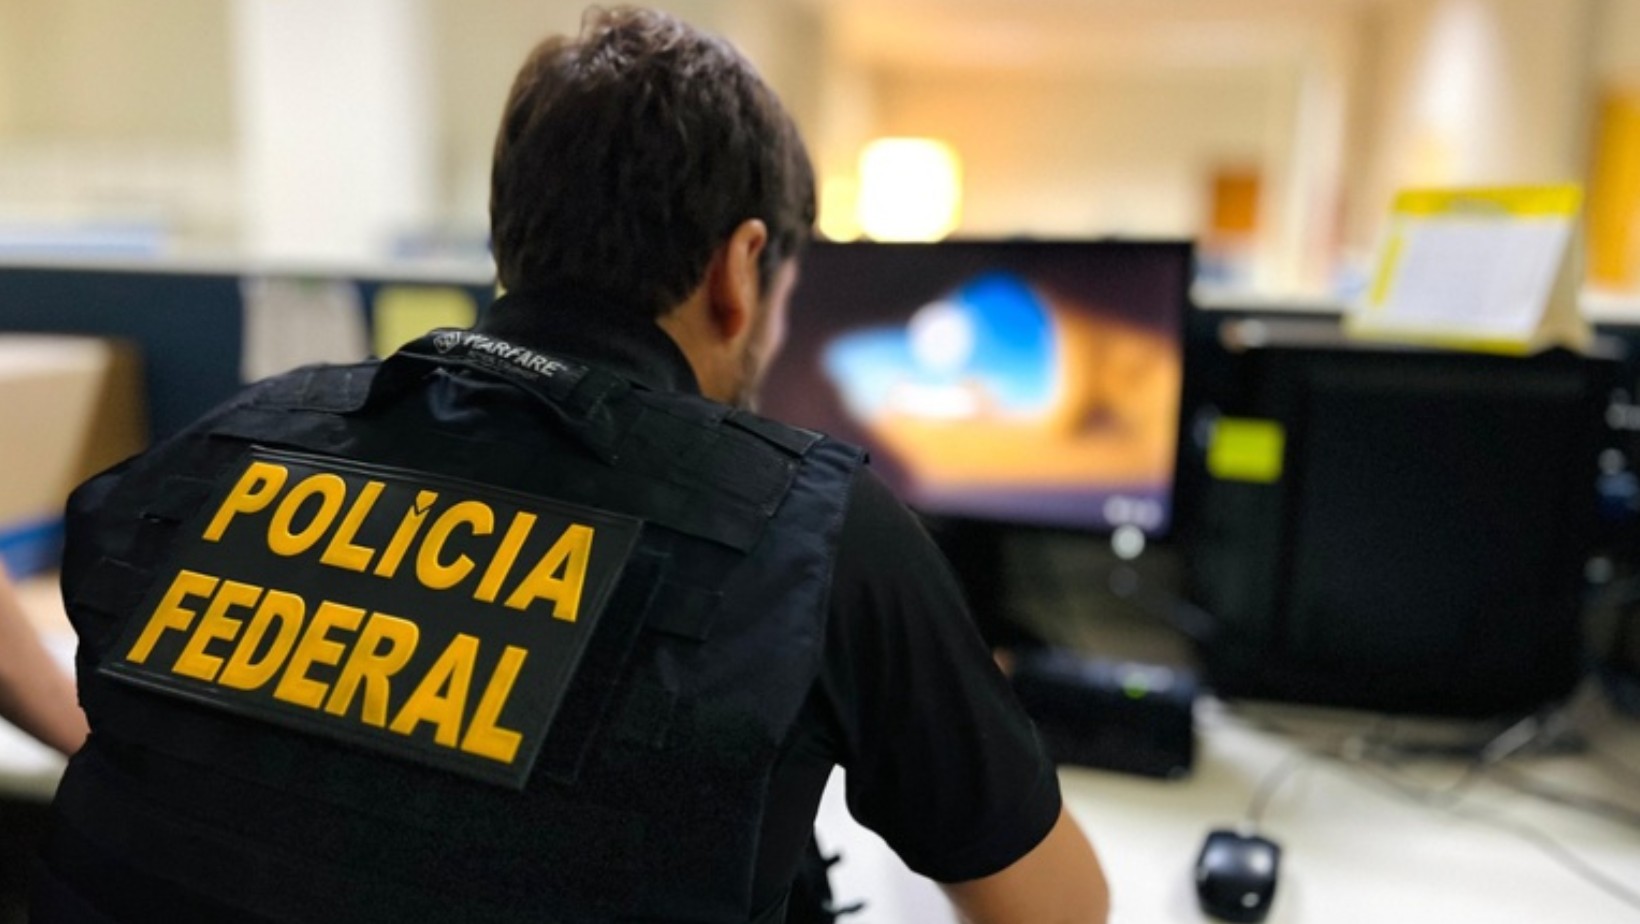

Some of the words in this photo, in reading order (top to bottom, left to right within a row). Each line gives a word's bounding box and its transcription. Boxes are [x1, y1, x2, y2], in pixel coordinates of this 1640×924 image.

[463, 334, 555, 377] WARFARE
[202, 460, 595, 622] POLÍCIA
[126, 569, 529, 763] FEDERAL
